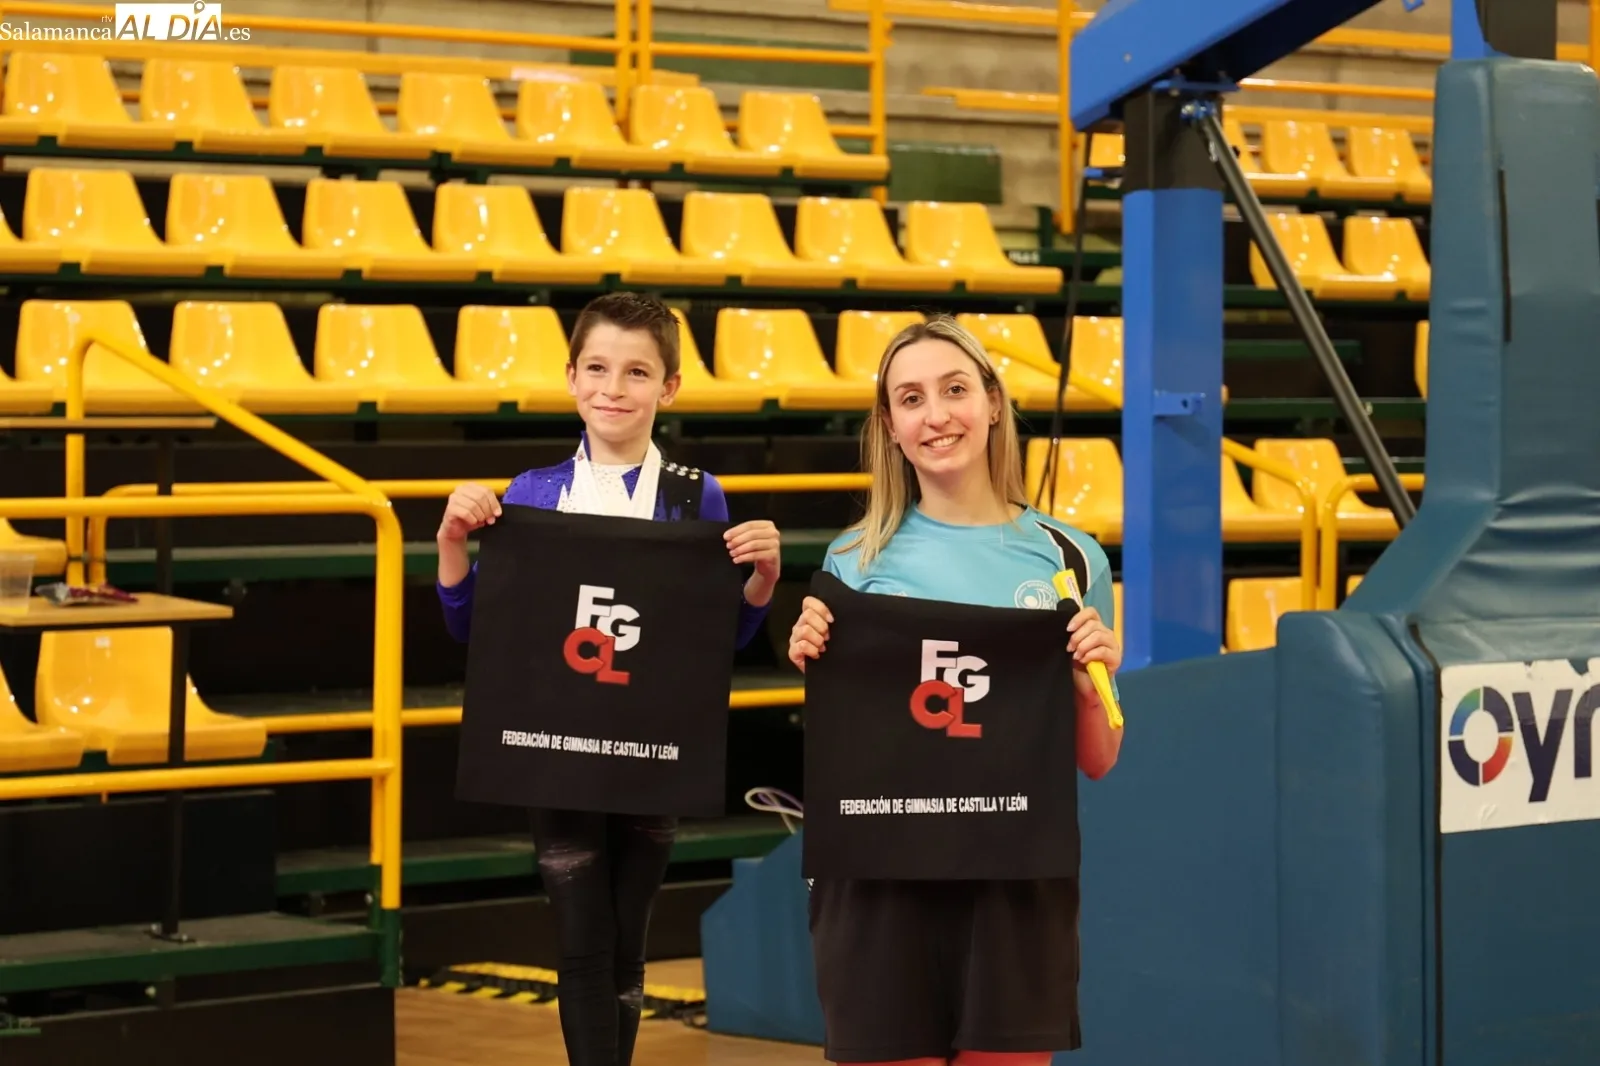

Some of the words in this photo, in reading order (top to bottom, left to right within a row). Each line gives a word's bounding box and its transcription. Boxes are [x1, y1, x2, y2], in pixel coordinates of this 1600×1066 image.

[502, 730, 551, 749] FEDERACIÓN
[551, 735, 563, 750] DE
[563, 736, 600, 754] GIMNASIA
[602, 740, 613, 755] DE
[613, 741, 650, 759] CASTILLA
[651, 744, 658, 759] Y
[658, 743, 679, 761] LEÓN
[840, 795, 891, 815] FEDERACIÓN
[892, 798, 904, 814] DE
[905, 798, 945, 814] GIMNASIA
[946, 797, 958, 813] DE
[959, 796, 998, 813] CASTILLA
[998, 796, 1005, 812] Y
[1006, 792, 1028, 812] LEÓN
